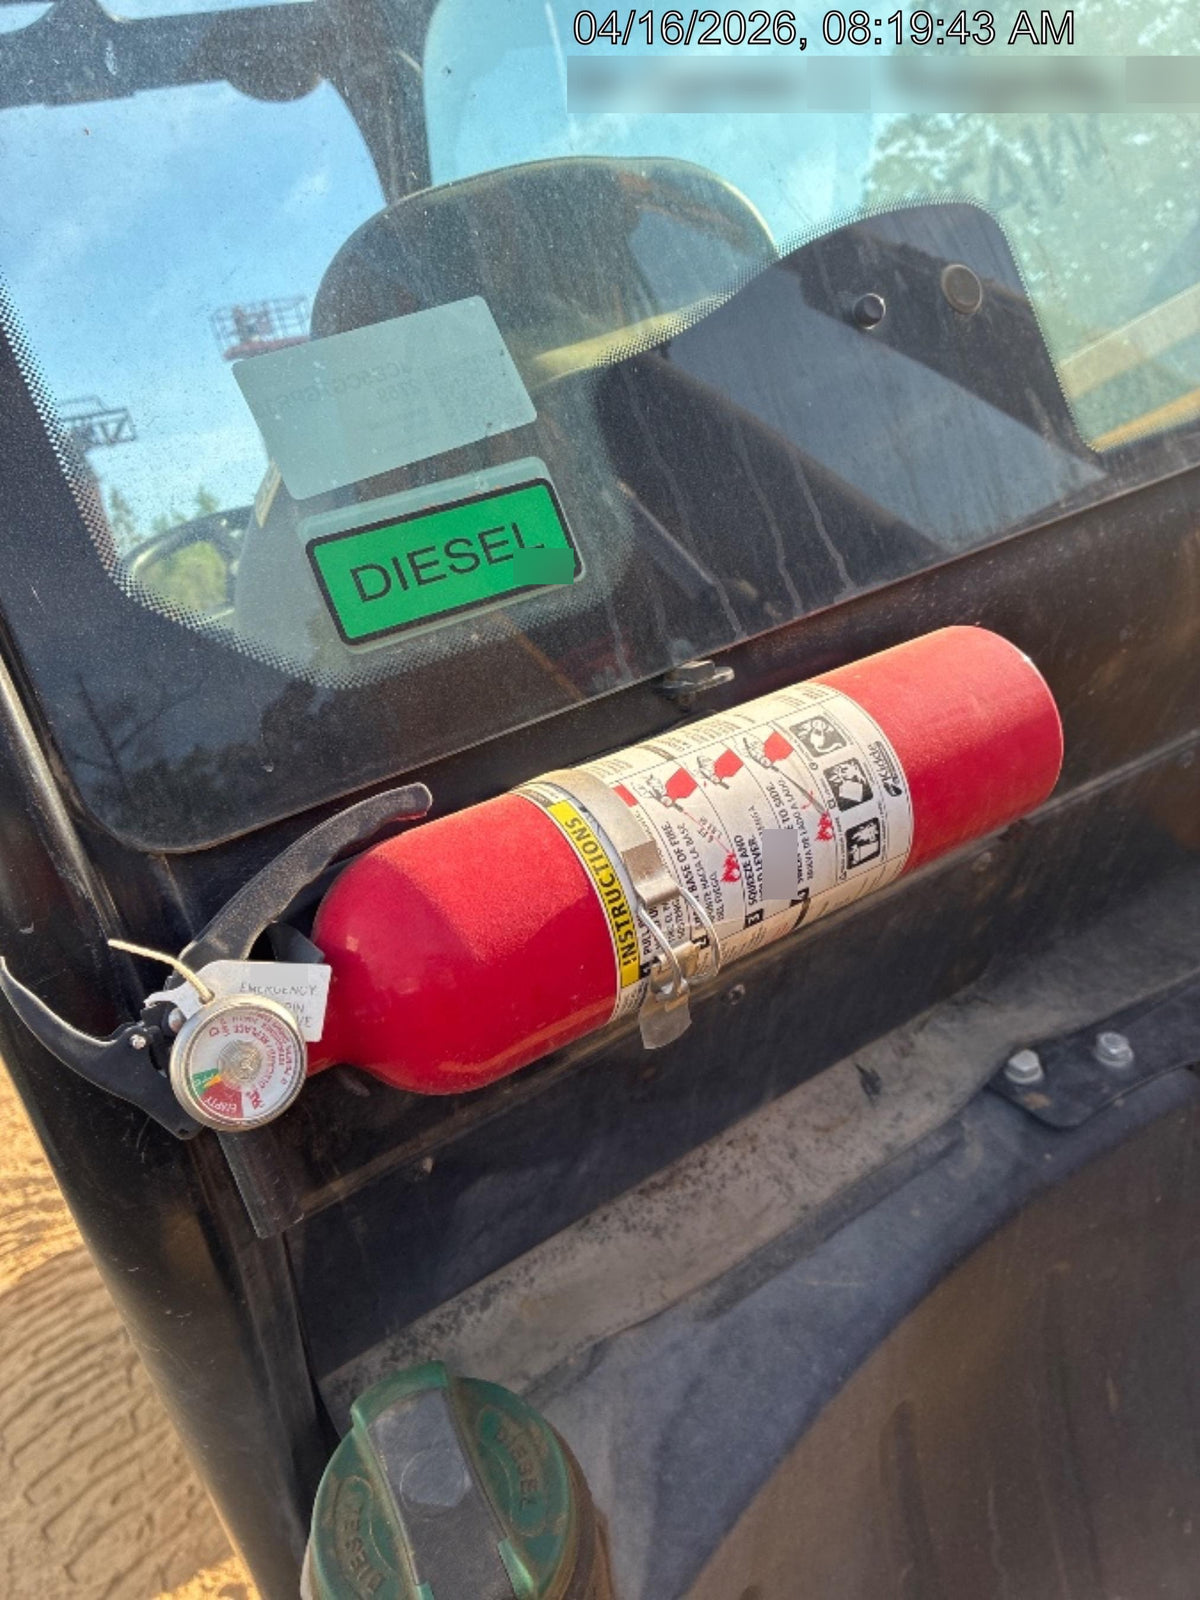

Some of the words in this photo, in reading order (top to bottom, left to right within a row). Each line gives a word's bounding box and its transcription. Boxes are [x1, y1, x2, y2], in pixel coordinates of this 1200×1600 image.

[349, 521, 545, 603] DIESEL
[867, 743, 893, 783] Kidde
[779, 809, 790, 822] TO
[674, 846, 687, 863] OF
[734, 835, 749, 858] AND
[564, 816, 638, 966] INSTRUCTIONS
[681, 864, 697, 893] BASE
[743, 860, 757, 906] SQUEEZE
[239, 981, 317, 996] EMERGENCY
[205, 1096, 238, 1113] EMPTY
